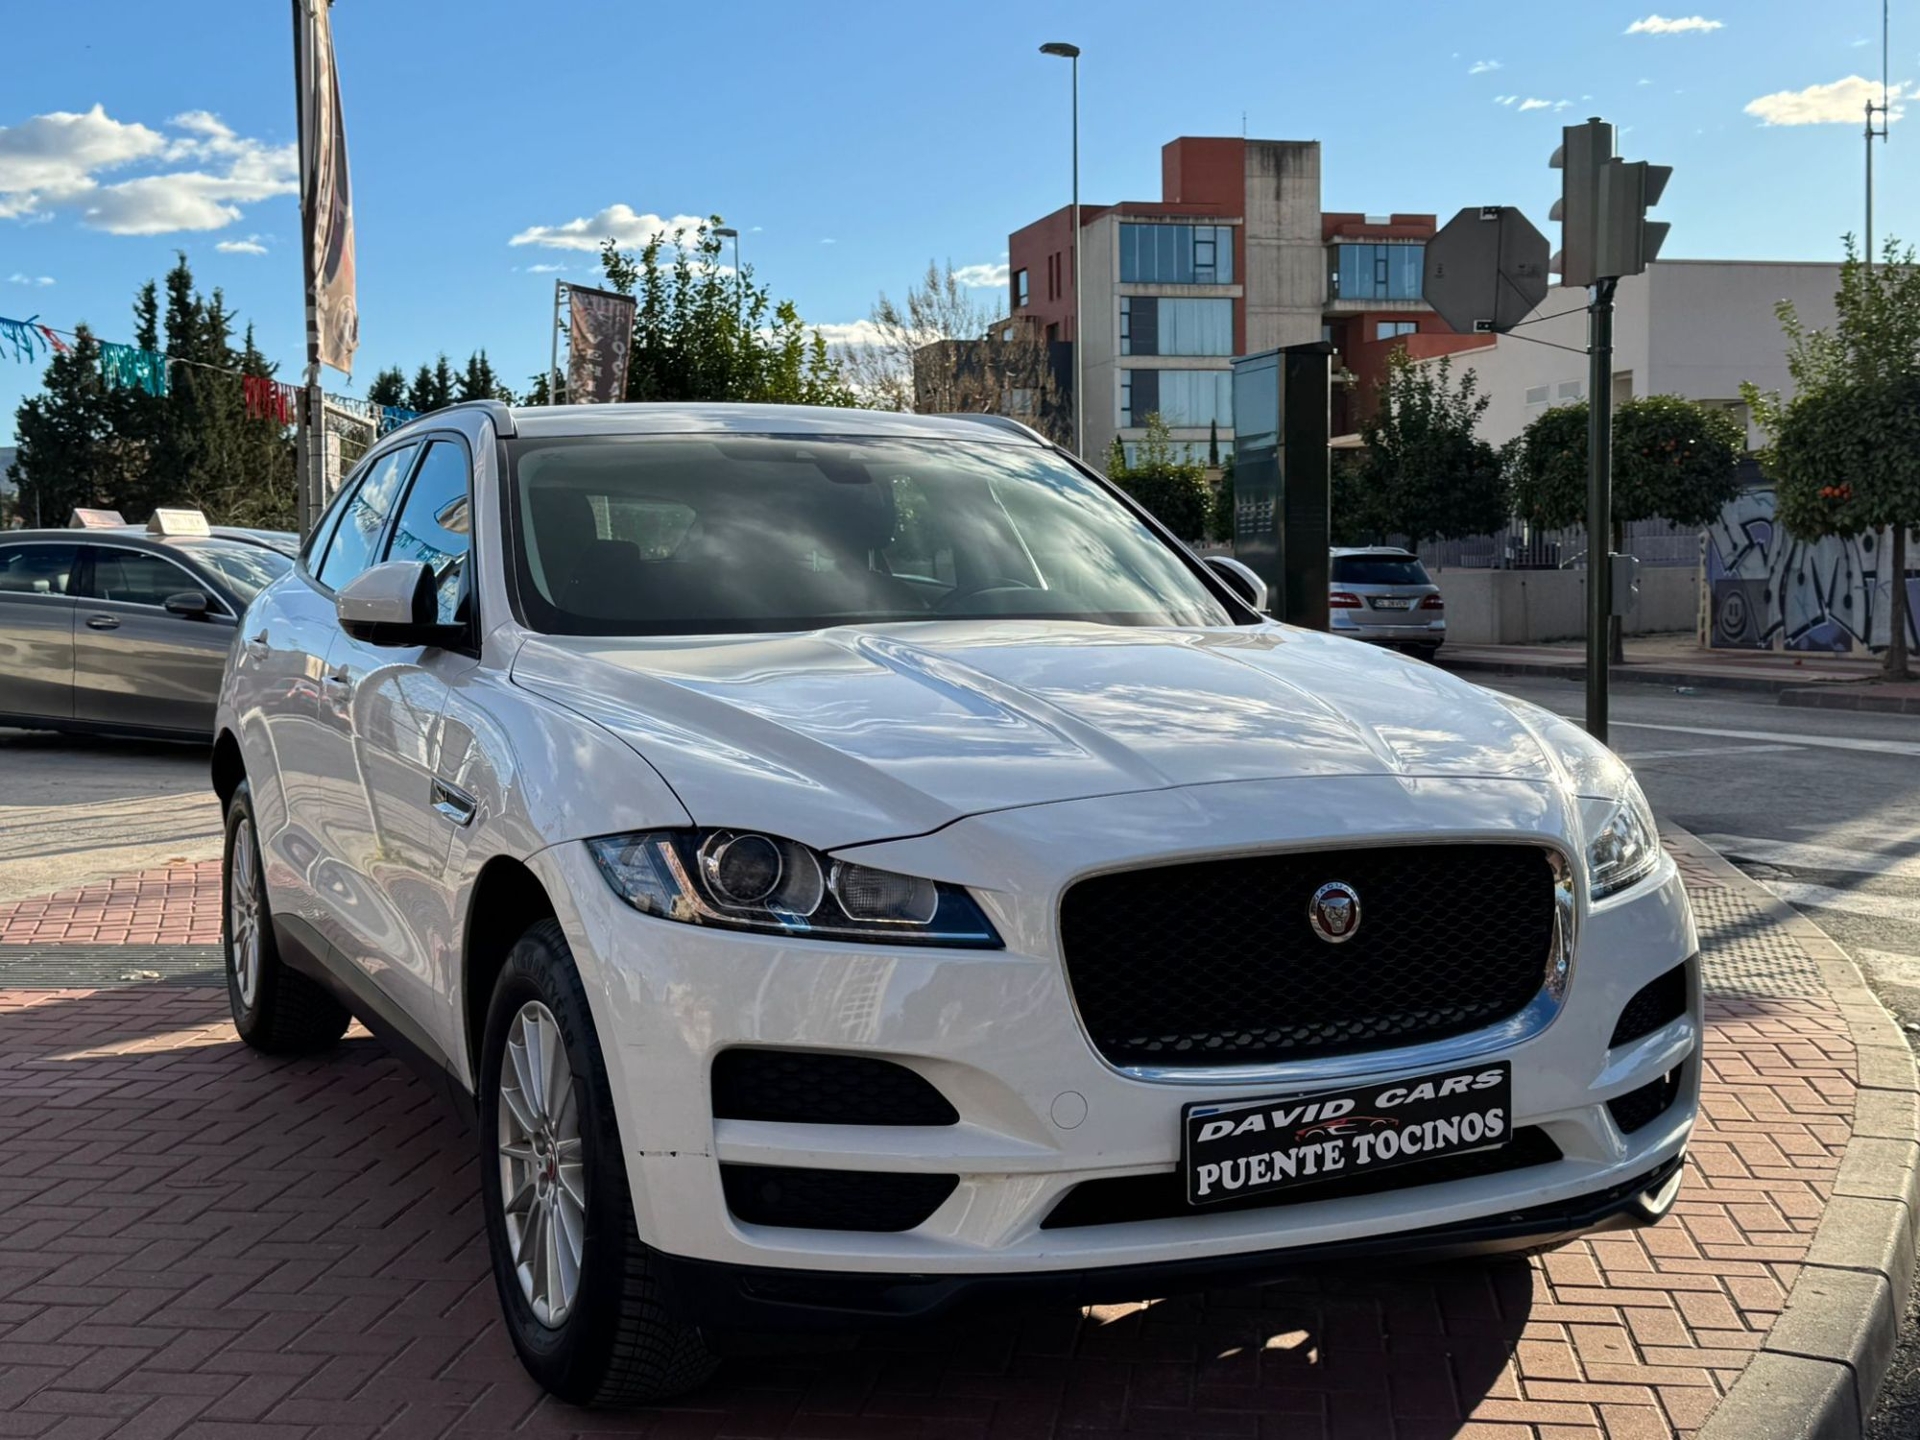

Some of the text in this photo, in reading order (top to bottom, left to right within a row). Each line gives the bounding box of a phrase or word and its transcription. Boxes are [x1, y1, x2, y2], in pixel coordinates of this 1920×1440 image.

[1314, 883, 1356, 900] JAGUAR
[1197, 1069, 1505, 1141] DAVID CARS
[1196, 1108, 1505, 1196] PUENTE TOCINOS
